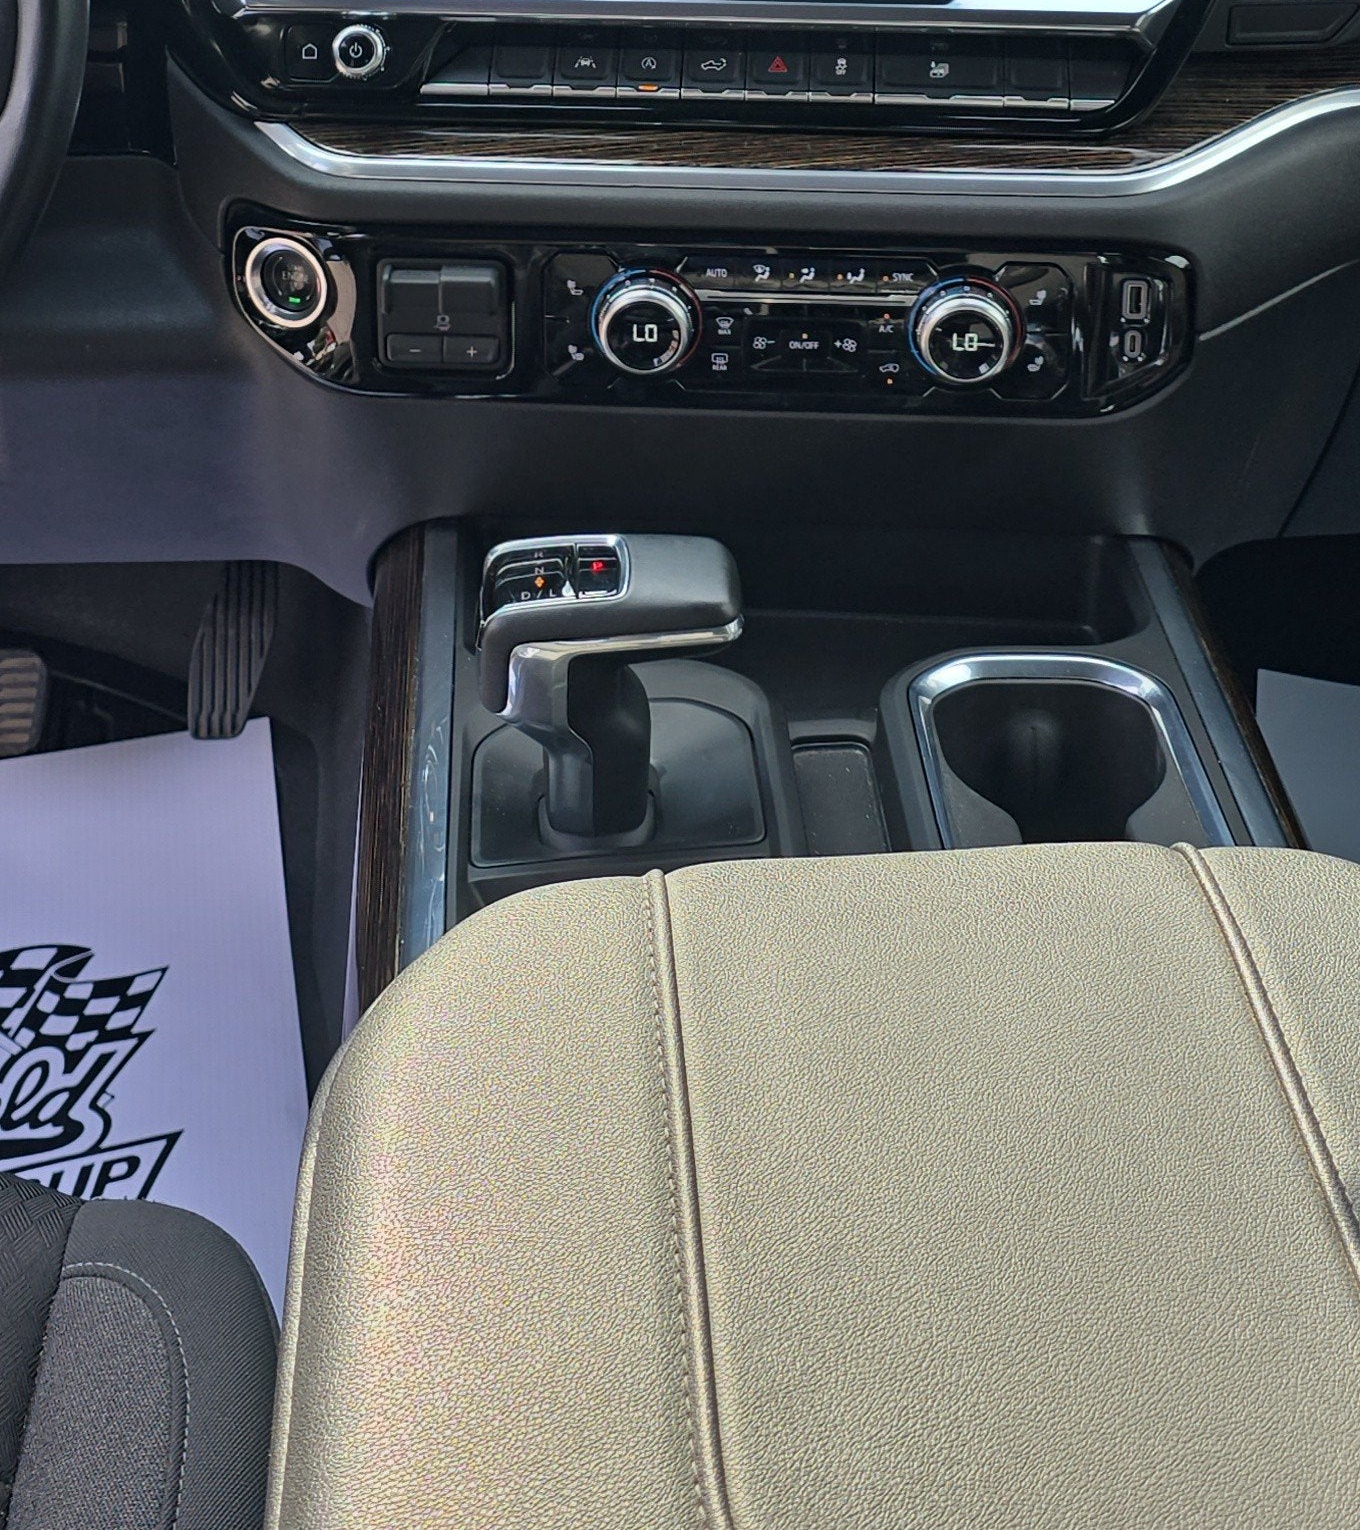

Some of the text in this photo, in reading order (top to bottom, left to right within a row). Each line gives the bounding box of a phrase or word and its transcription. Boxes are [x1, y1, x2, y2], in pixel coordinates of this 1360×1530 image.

[705, 268, 728, 278] AUTO
[892, 272, 914, 283] SYNC
[878, 324, 894, 334] A/C
[789, 340, 820, 350] ON/OFF
[535, 566, 545, 575] N
